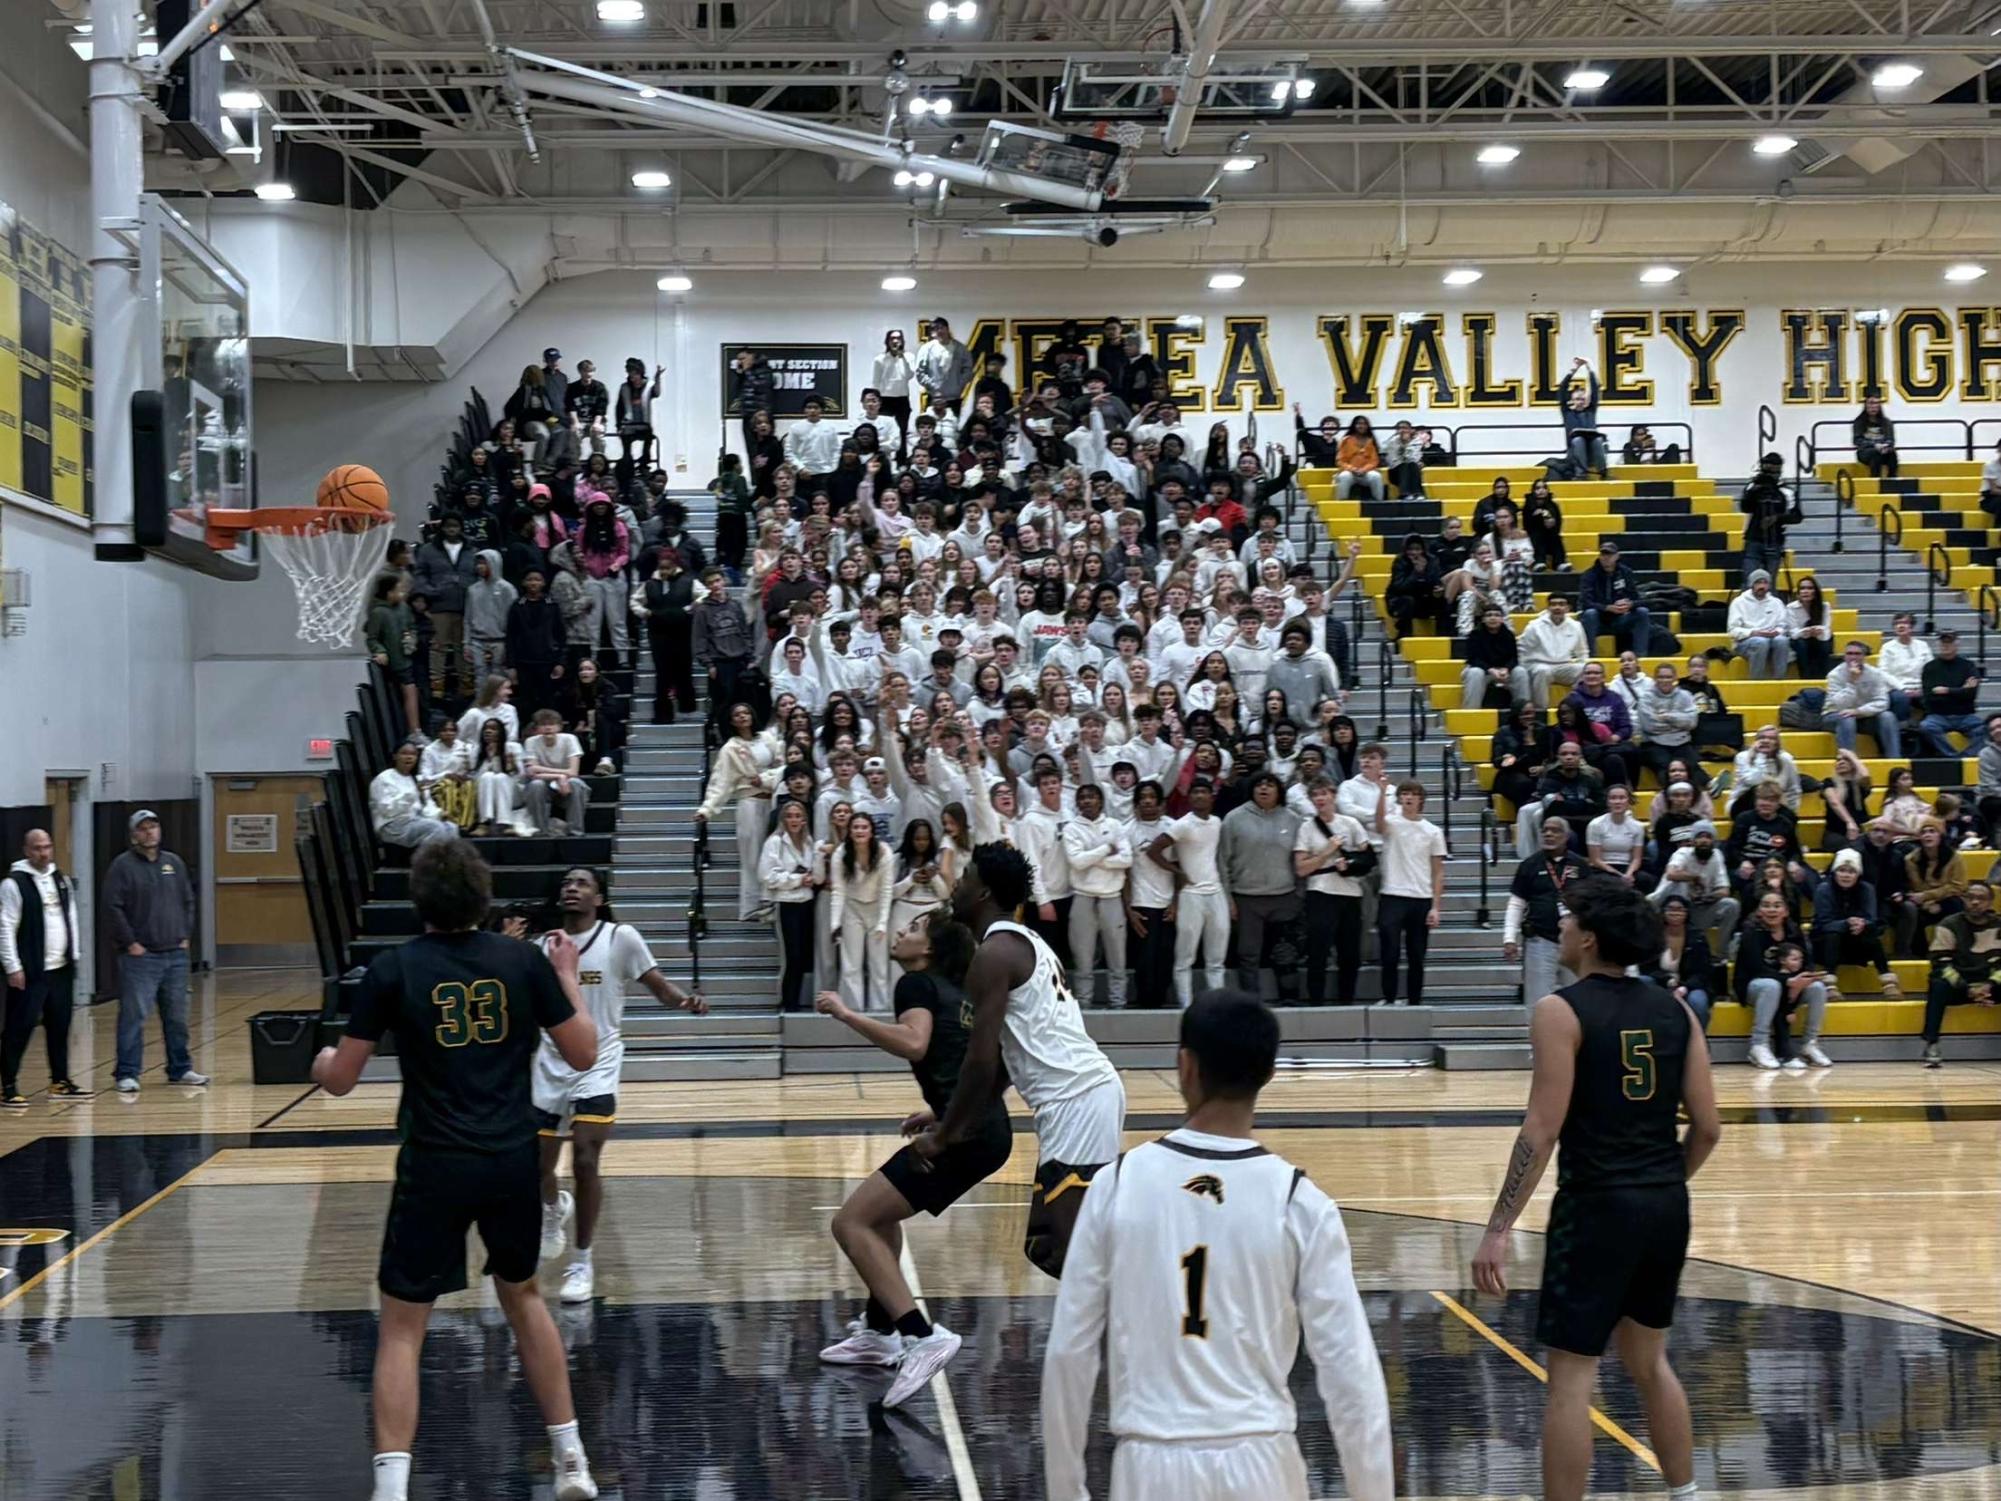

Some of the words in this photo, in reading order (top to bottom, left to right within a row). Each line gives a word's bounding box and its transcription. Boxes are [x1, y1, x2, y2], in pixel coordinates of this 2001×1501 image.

[772, 372, 815, 390] OME
[787, 359, 838, 370] SECTION
[918, 316, 1285, 412] MEEA
[1317, 310, 1746, 409] VALLEY
[1780, 308, 2001, 404] HIGH
[431, 978, 509, 1048] 33
[1620, 1029, 1656, 1101] 5
[1180, 1243, 1209, 1340] 1
